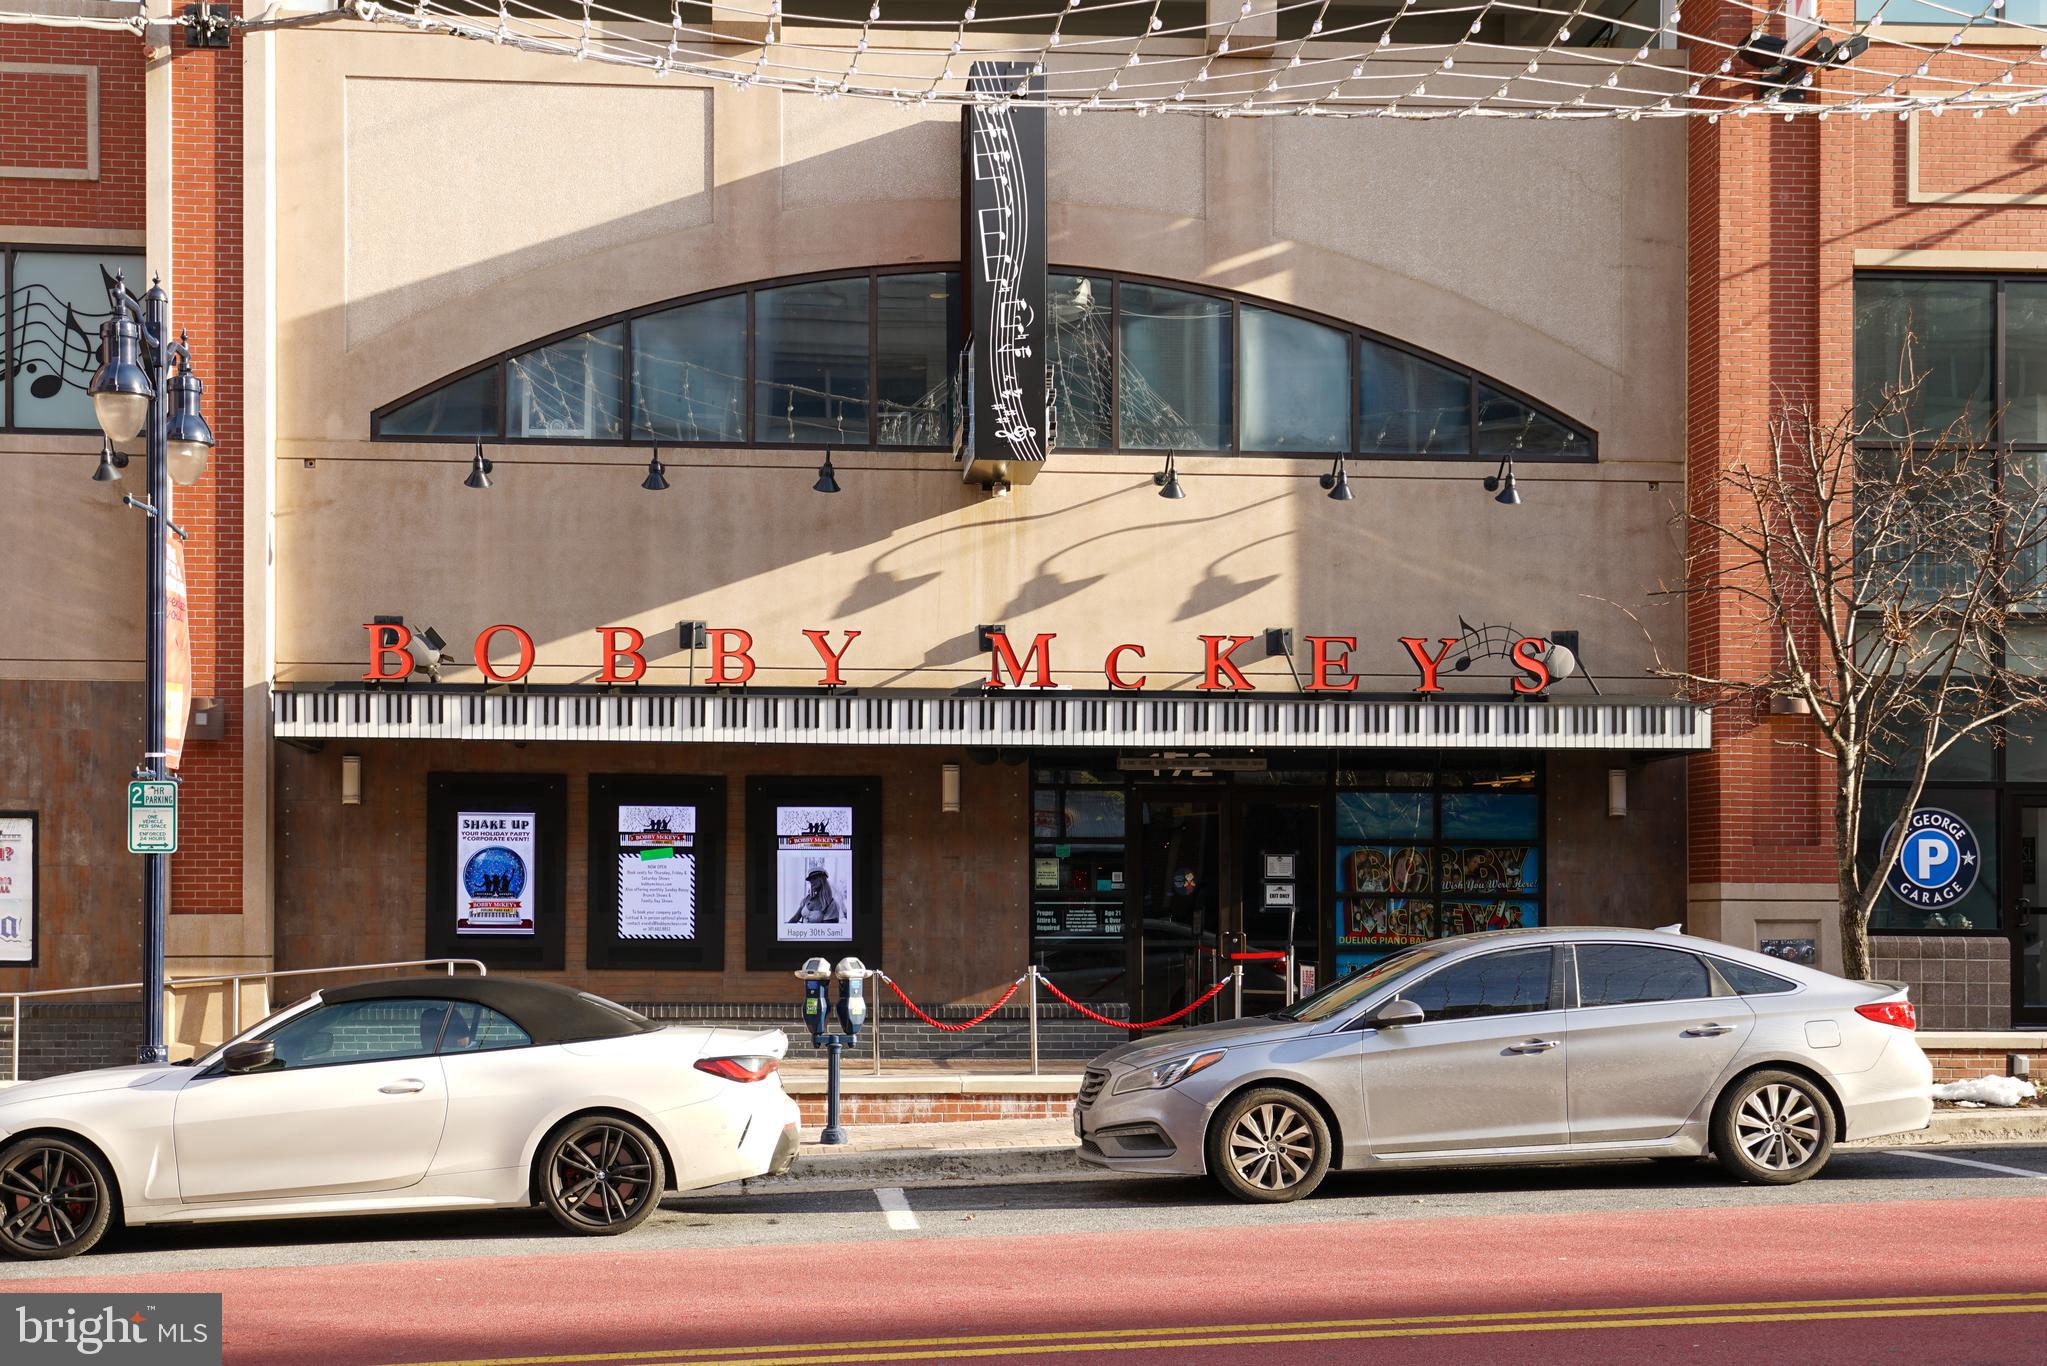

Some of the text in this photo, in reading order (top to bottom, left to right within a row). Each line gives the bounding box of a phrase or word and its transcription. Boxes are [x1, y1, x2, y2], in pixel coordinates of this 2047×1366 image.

[362, 622, 861, 686] BOBBY
[132, 786, 165, 804] 2 HR
[145, 796, 173, 804] PARKING
[463, 819, 529, 829] SHAKE UP
[1913, 814, 1966, 840] GEORGE
[1918, 839, 1949, 879] P
[1440, 879, 1539, 891] Wish You Were Here!
[1900, 881, 1963, 903] GARAGE
[787, 928, 843, 938] Happy 30th Sam!
[1104, 924, 1121, 933] ONLY
[1339, 936, 1428, 945] DUELING PIANO BAR
